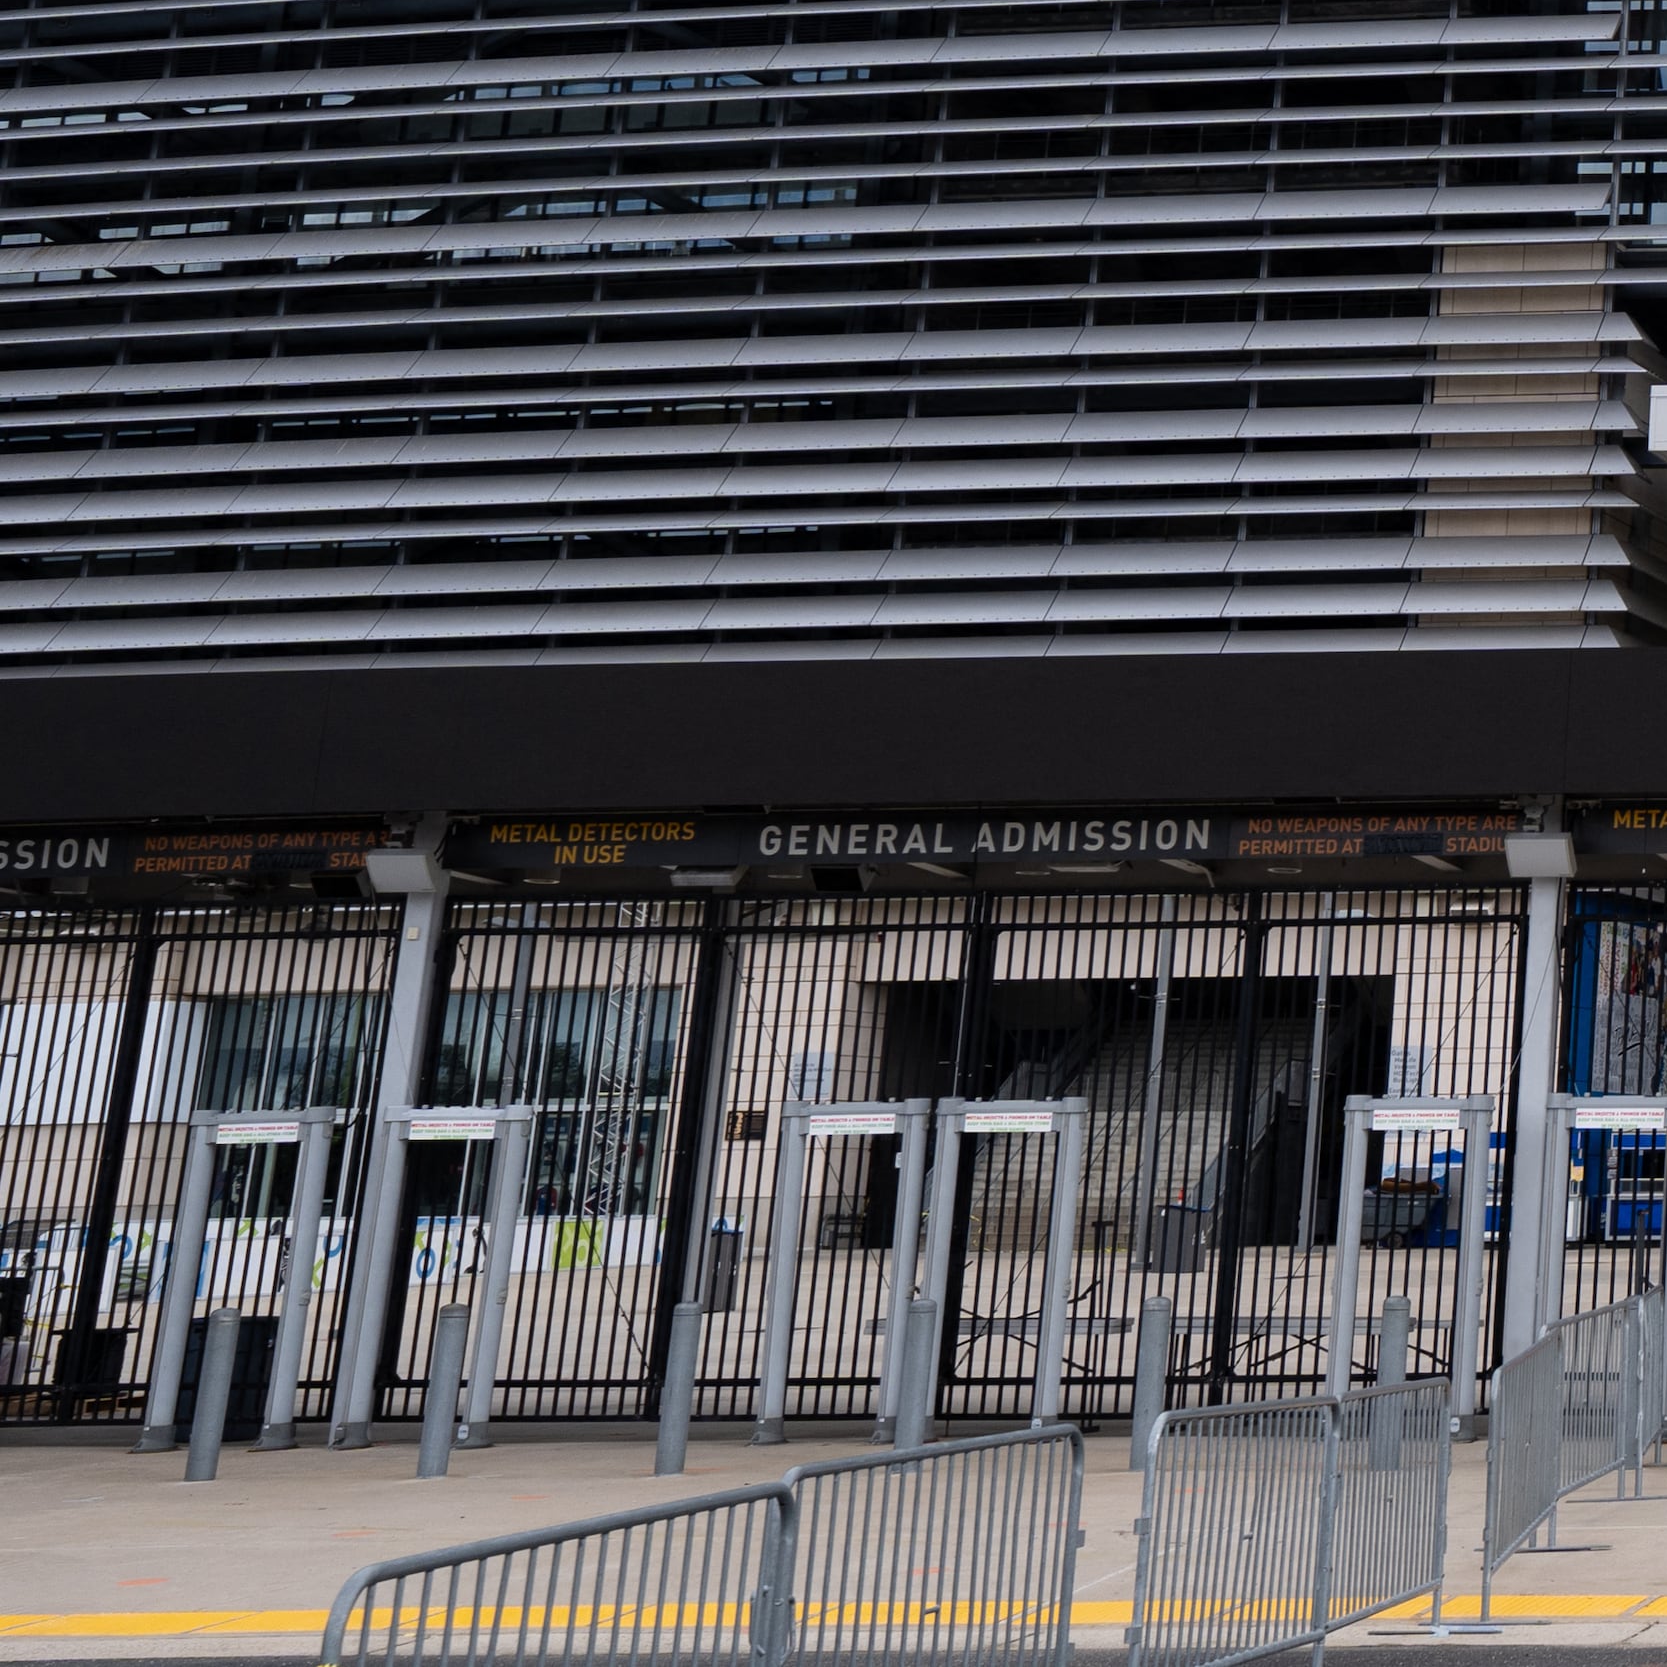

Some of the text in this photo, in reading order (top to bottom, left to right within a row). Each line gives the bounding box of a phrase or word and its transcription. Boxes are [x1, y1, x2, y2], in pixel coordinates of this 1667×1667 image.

[490, 822, 695, 842] METAL DETECTORS
[1248, 815, 1515, 833] NO WEAPONS OF ANY TYPE ARE
[145, 834, 173, 851] NO
[178, 833, 254, 851] WEAPONS
[258, 832, 278, 848] OF
[282, 831, 316, 847] ANY
[321, 831, 360, 847] TYPE
[760, 819, 1209, 856] GENERAL ADMISSION
[1238, 839, 1338, 855] PERMITTED
[1342, 838, 1362, 853] AT
[554, 845, 624, 863] IN USE
[134, 856, 228, 872] PERMITTED
[232, 855, 251, 869] AT
